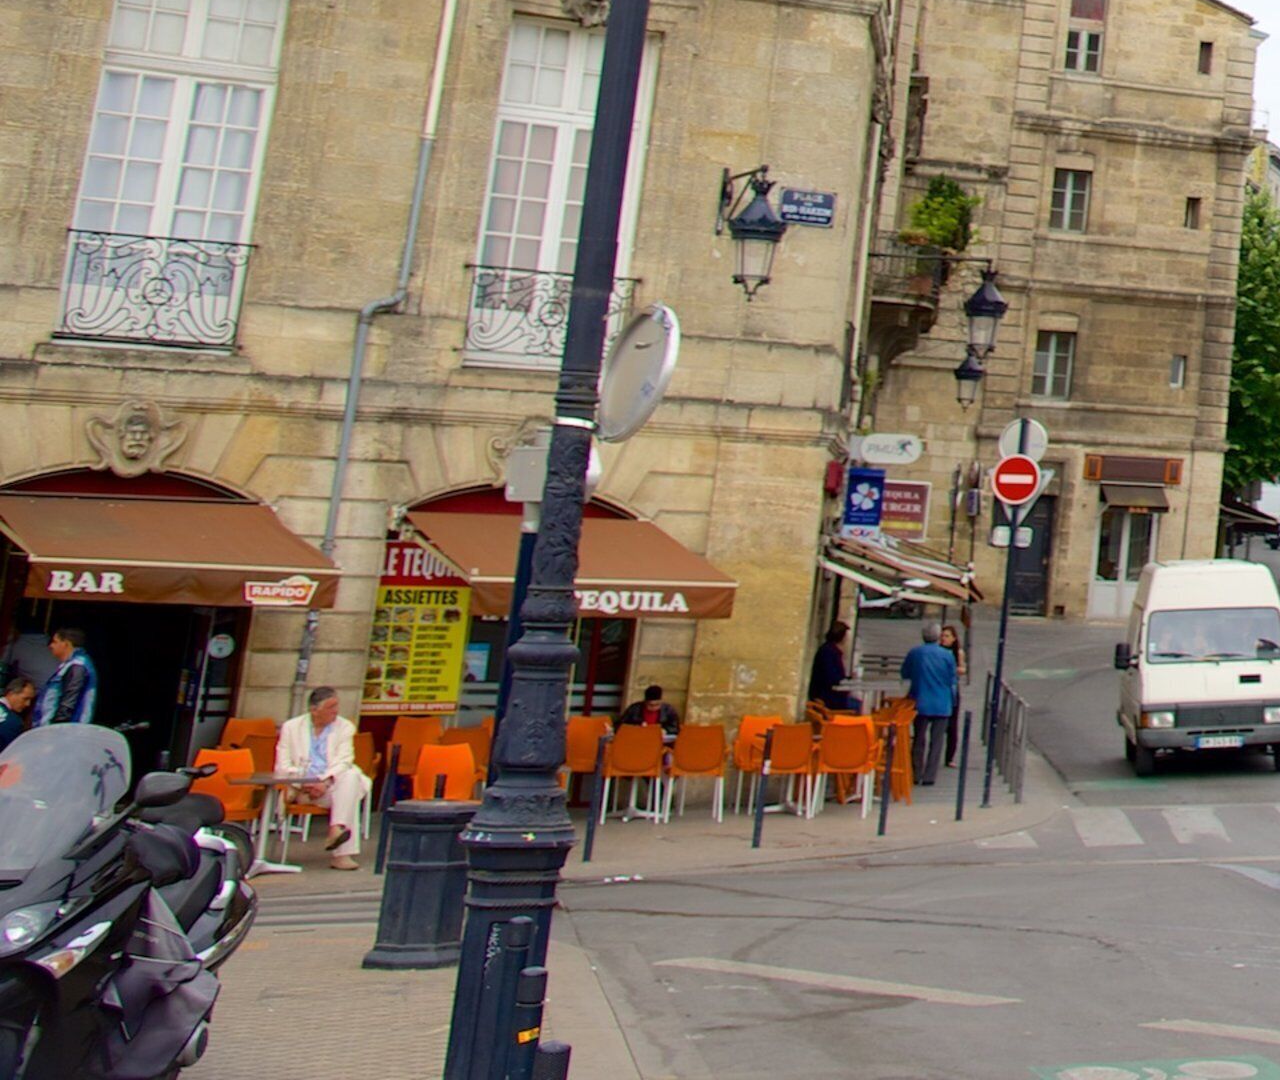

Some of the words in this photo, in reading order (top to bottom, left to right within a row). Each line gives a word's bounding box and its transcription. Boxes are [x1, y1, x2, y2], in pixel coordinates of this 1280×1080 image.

[884, 490, 920, 500] EQUILA
[882, 502, 922, 513] URGER
[48, 571, 125, 593] BAR
[252, 586, 305, 598] RAPIDO
[384, 589, 459, 605] ASSIETTES
[574, 590, 689, 614] EQUILA
